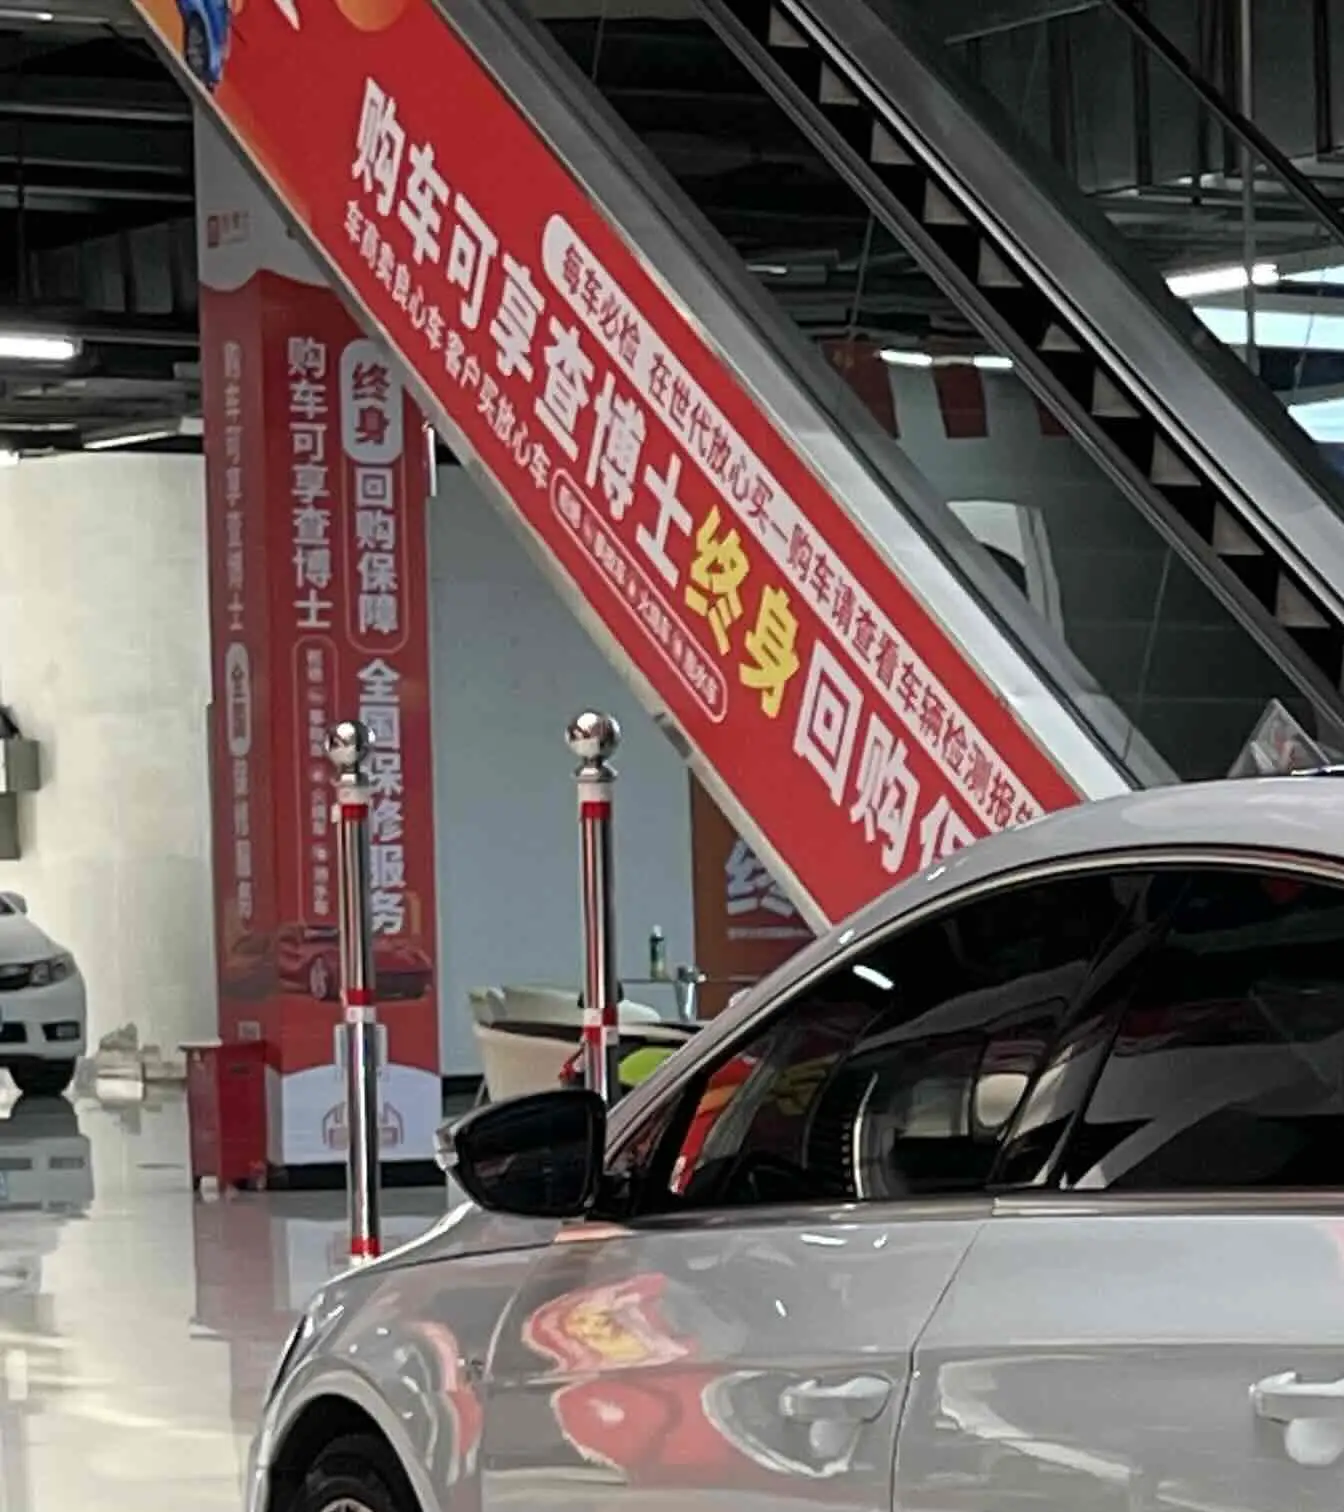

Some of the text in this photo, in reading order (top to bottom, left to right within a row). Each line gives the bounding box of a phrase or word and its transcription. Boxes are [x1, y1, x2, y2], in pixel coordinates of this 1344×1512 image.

[287, 336, 333, 628] 购车可享查博士
